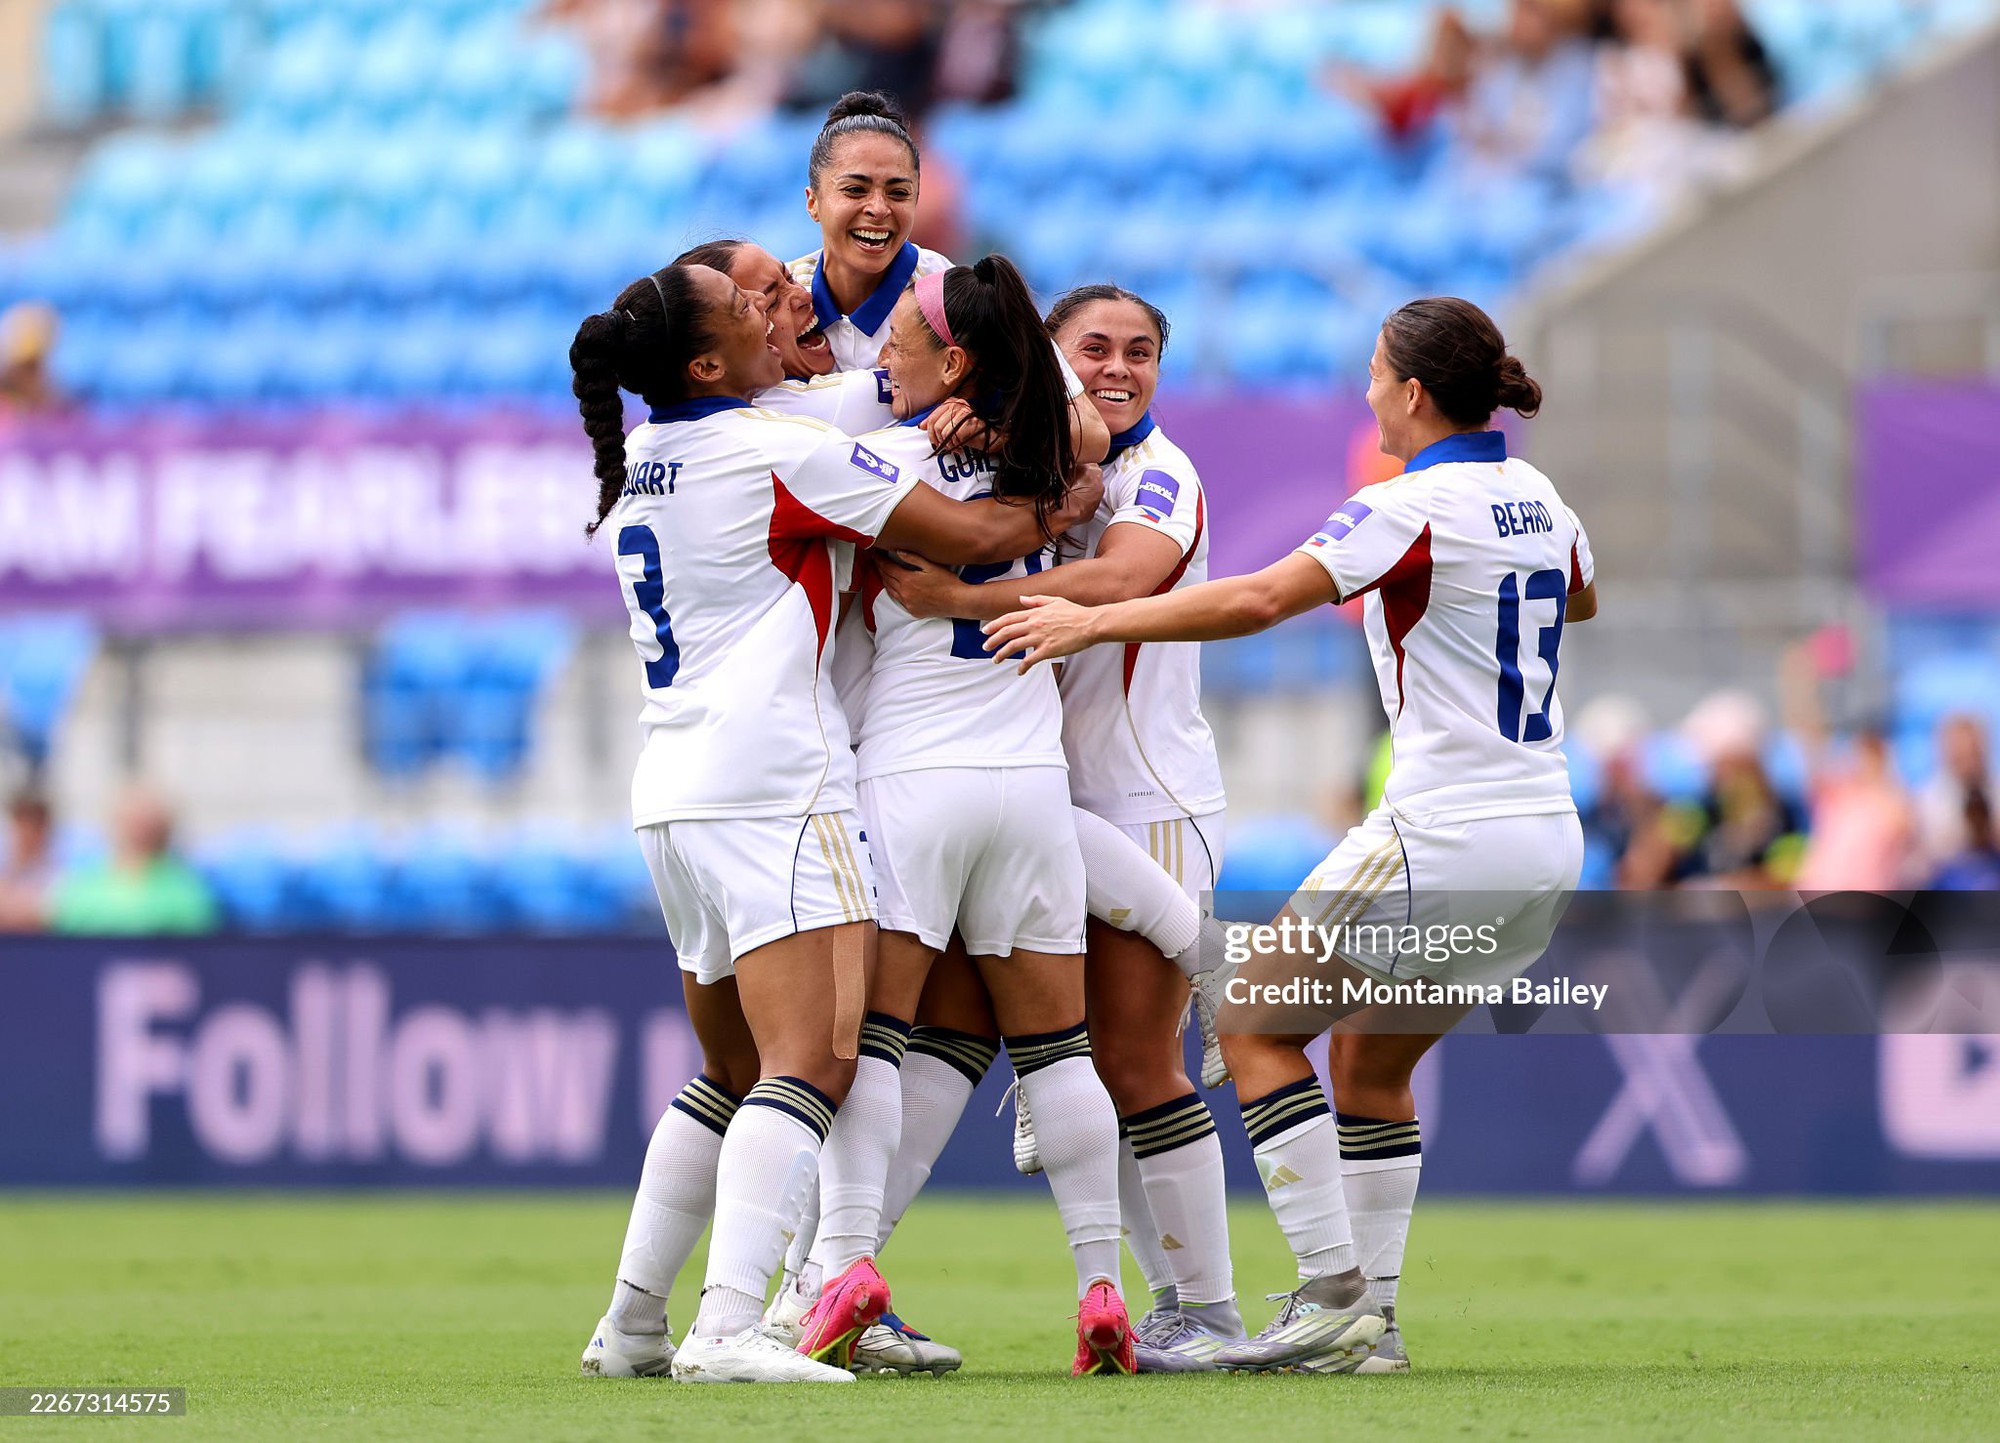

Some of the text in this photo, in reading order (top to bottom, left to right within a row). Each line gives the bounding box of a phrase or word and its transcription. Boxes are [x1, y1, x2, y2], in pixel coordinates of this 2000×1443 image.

[155, 446, 606, 582] FEARLES
[624, 461, 684, 497] WART
[936, 447, 998, 483] GUIL
[1491, 500, 1554, 538] BEARD
[618, 525, 680, 689] 3
[1496, 569, 1567, 743] 13
[95, 962, 617, 1164] Follow
